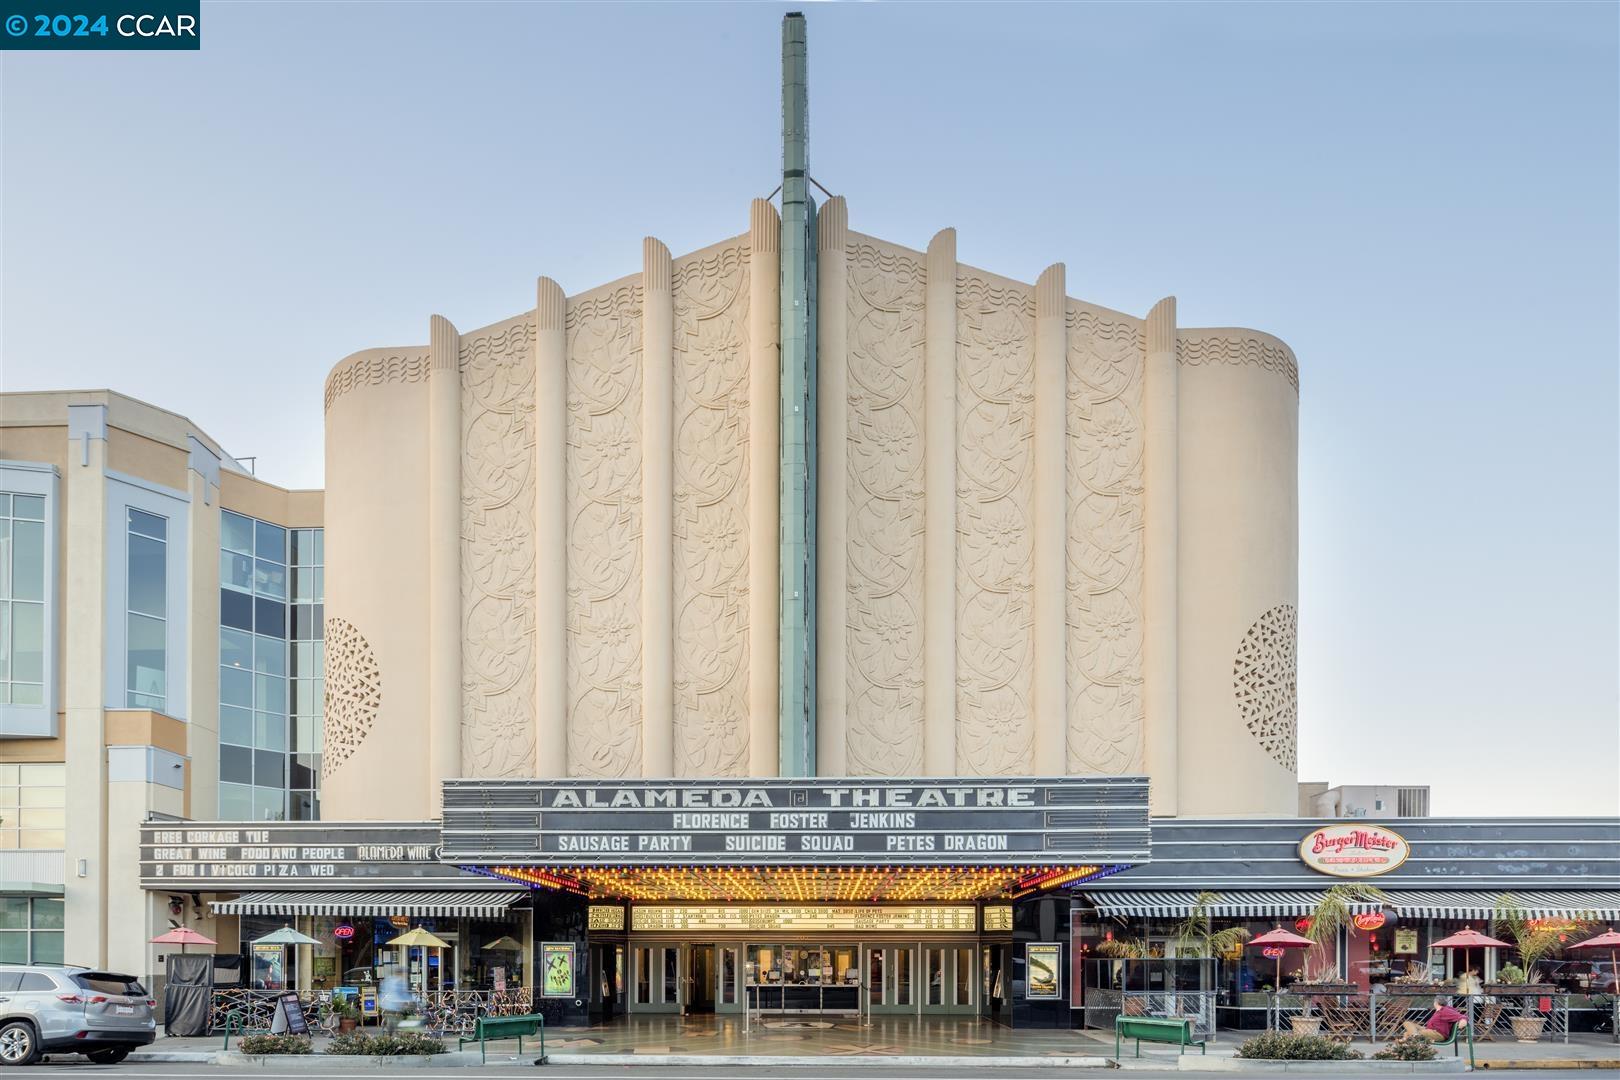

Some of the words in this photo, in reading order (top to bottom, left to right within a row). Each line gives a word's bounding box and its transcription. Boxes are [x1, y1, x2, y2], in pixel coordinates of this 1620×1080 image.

[552, 789, 773, 808] ALAMEDA
[823, 788, 1035, 807] THEATRE
[673, 813, 749, 829] FLORENCE
[770, 813, 828, 829] FOSTER
[850, 813, 915, 828] JENKINS
[154, 831, 182, 843] FREE
[187, 831, 239, 843] CORKAGE
[246, 831, 269, 843] TUE
[559, 836, 629, 851] SAUSAGE
[639, 836, 691, 851] PARTY
[725, 836, 786, 851] SUICIDE
[801, 836, 854, 851] SQUAD
[887, 836, 935, 850] PETES
[944, 835, 1007, 850] DRAGON
[154, 848, 192, 860] GREAT
[198, 848, 227, 860] WINE
[241, 848, 270, 859] FOOD
[272, 848, 297, 859] AND
[302, 848, 344, 859] PEOPLE
[358, 846, 403, 860] ALAMEDA
[407, 846, 431, 860] WINE
[173, 865, 195, 876] FOR
[211, 865, 256, 876] VICOLO
[264, 865, 298, 876] PIZZA
[310, 865, 334, 876] WED
[335, 927, 354, 936] OPEN
[1263, 948, 1285, 957] OPEN
